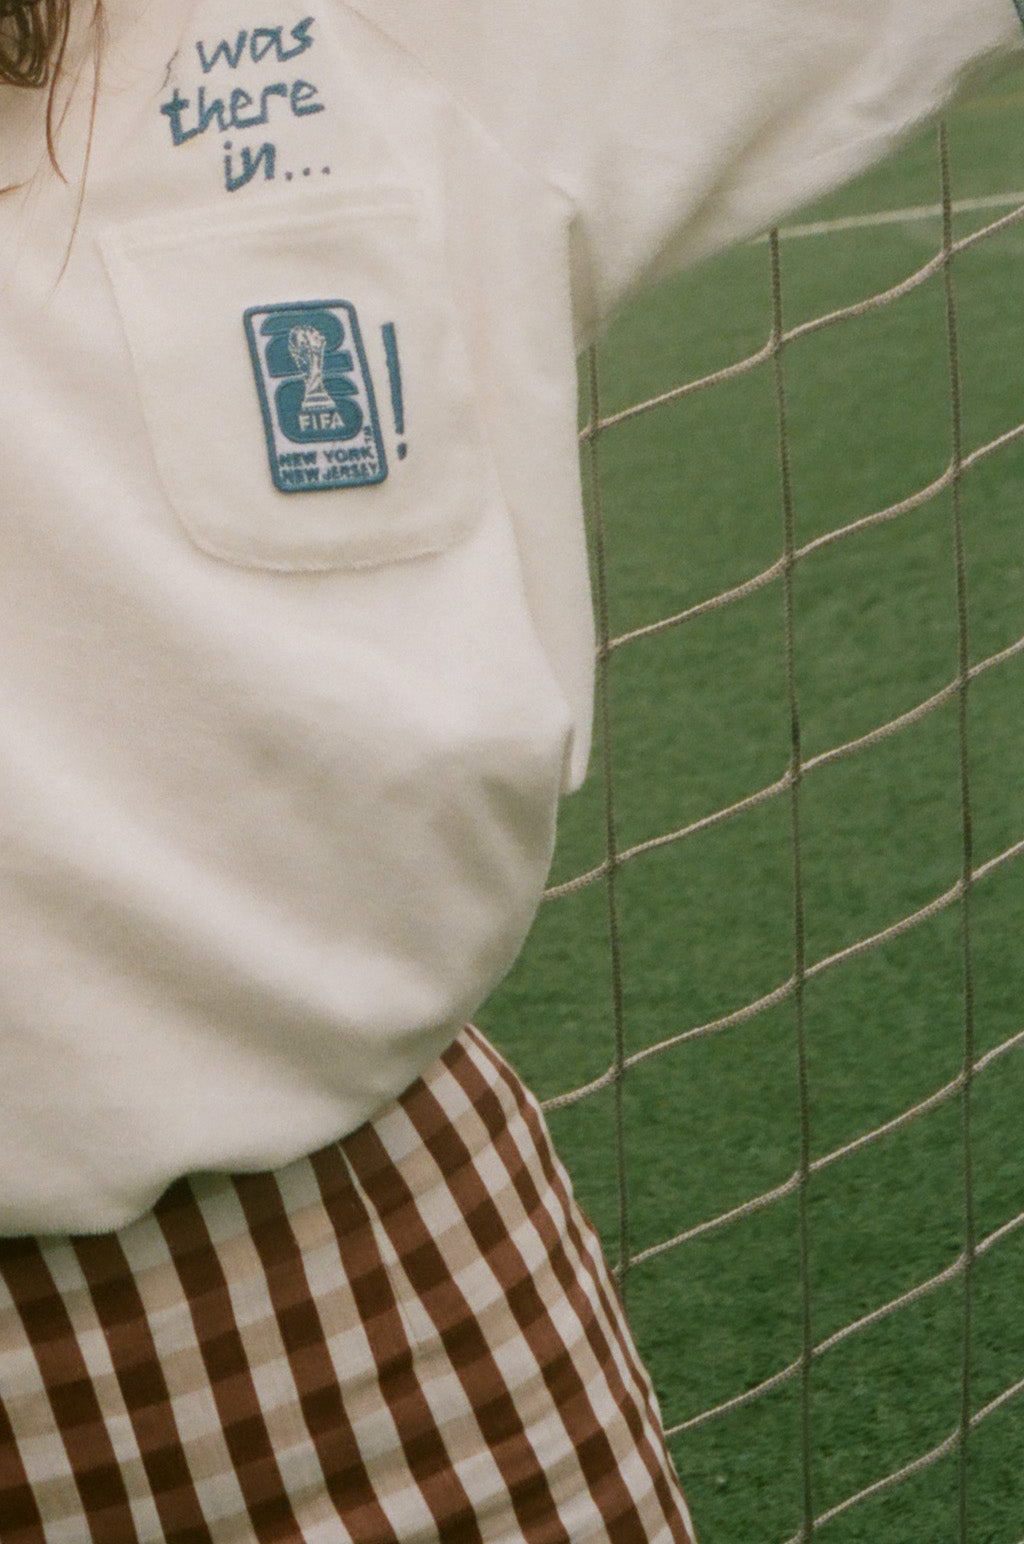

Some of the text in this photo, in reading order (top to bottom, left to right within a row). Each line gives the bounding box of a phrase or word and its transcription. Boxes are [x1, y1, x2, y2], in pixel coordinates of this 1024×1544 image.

[196, 16, 315, 74] was
[160, 79, 324, 146] there
[298, 411, 345, 432] FIFA
[279, 446, 375, 467] NEW YORK
[282, 462, 378, 484] NEW JERSEY
